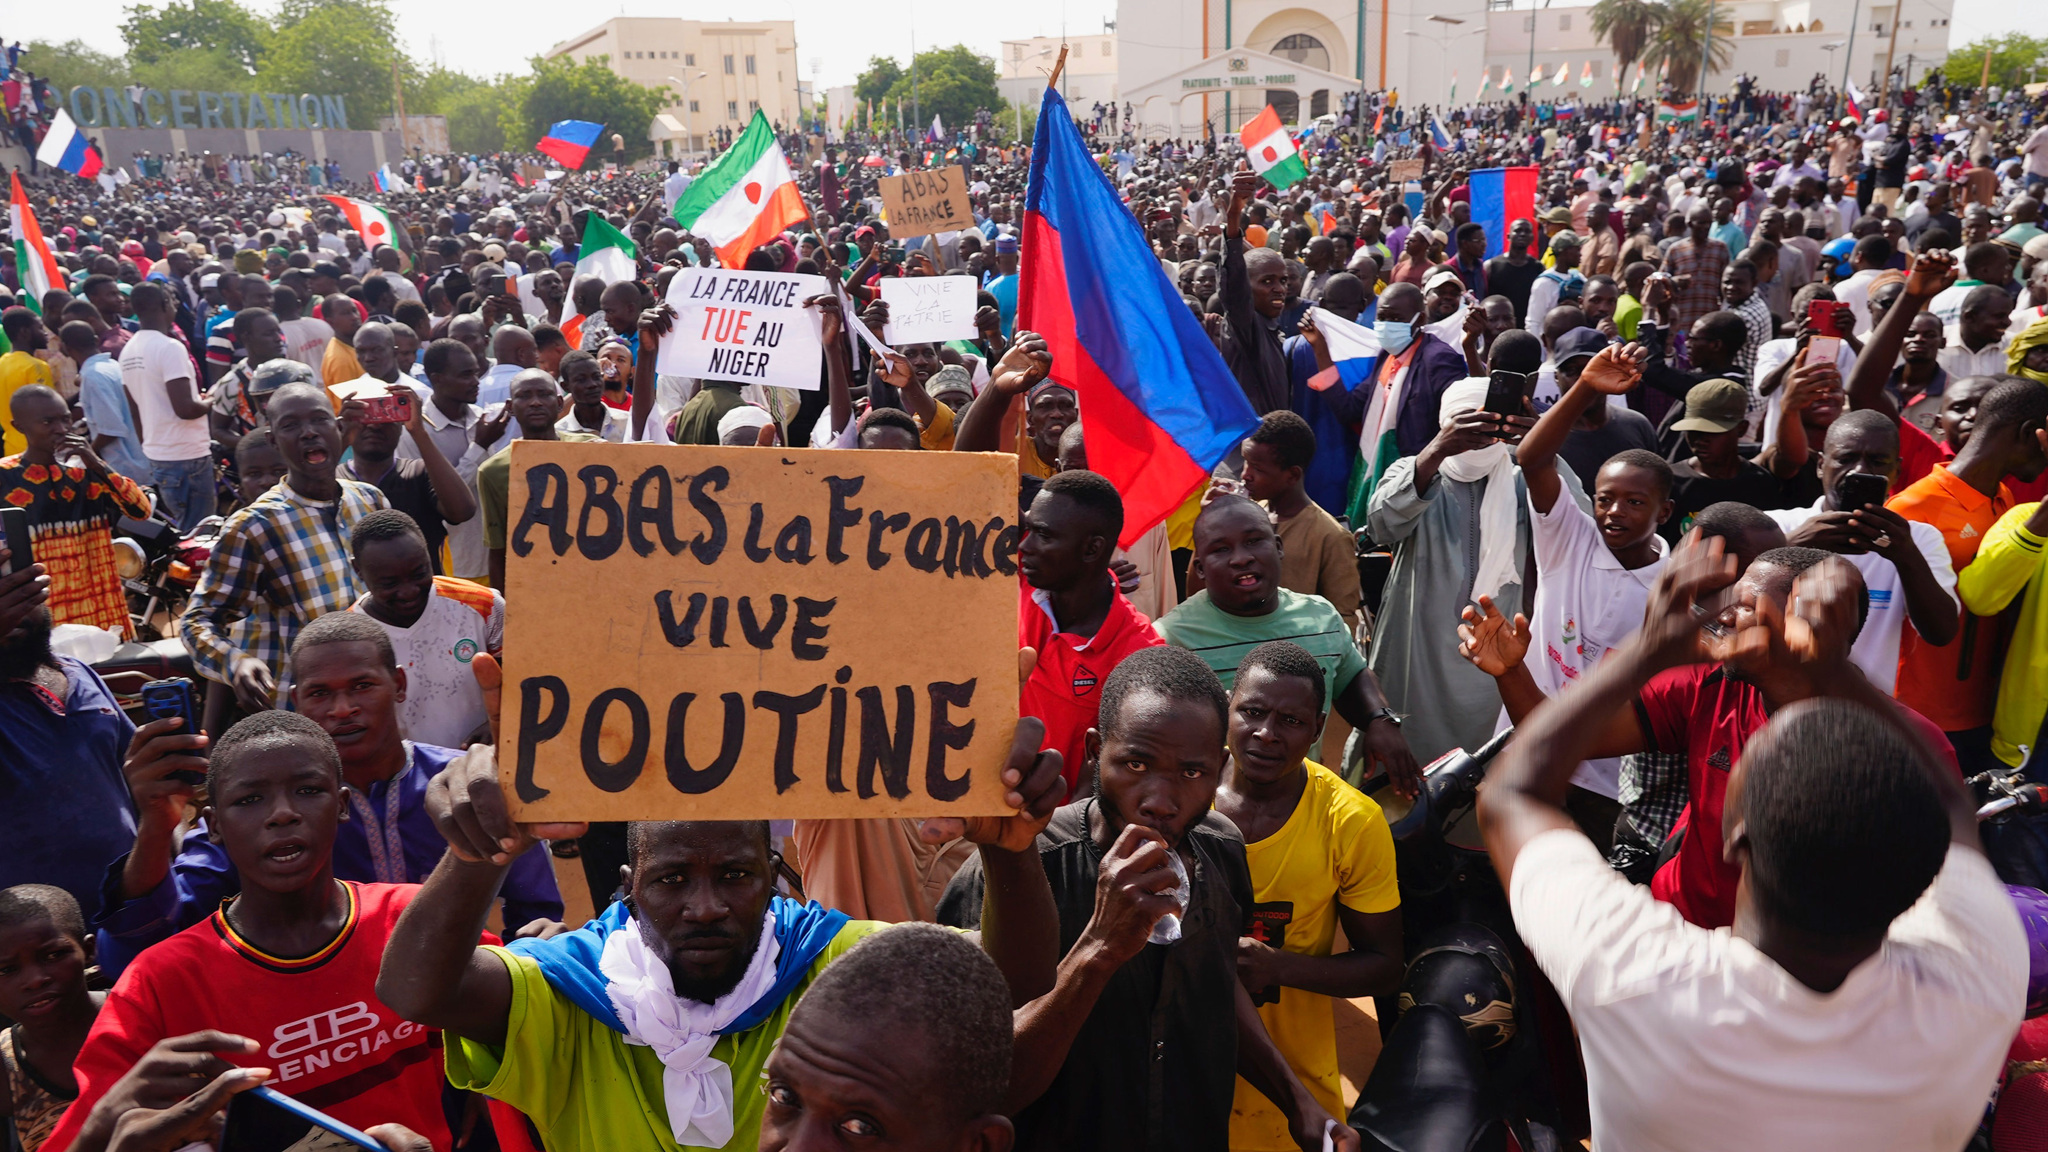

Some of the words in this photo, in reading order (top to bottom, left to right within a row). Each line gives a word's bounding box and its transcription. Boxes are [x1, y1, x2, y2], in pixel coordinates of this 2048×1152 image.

[1230, 76, 1257, 86] TRAVAIL
[901, 169, 949, 203] ABAS
[890, 209, 905, 226] LA
[906, 199, 954, 225] FRANCE
[690, 275, 718, 299] LA
[720, 278, 800, 308] FRANCE
[914, 299, 940, 312] LA
[701, 306, 753, 345] TUE
[752, 321, 784, 347] AU
[894, 310, 953, 329] PATRIE
[708, 348, 770, 378] NIGER
[511, 462, 731, 566] ABAS
[821, 475, 1019, 580] France
[653, 589, 838, 661] VIVE
[1253, 911, 1290, 919] OUTDOOR
